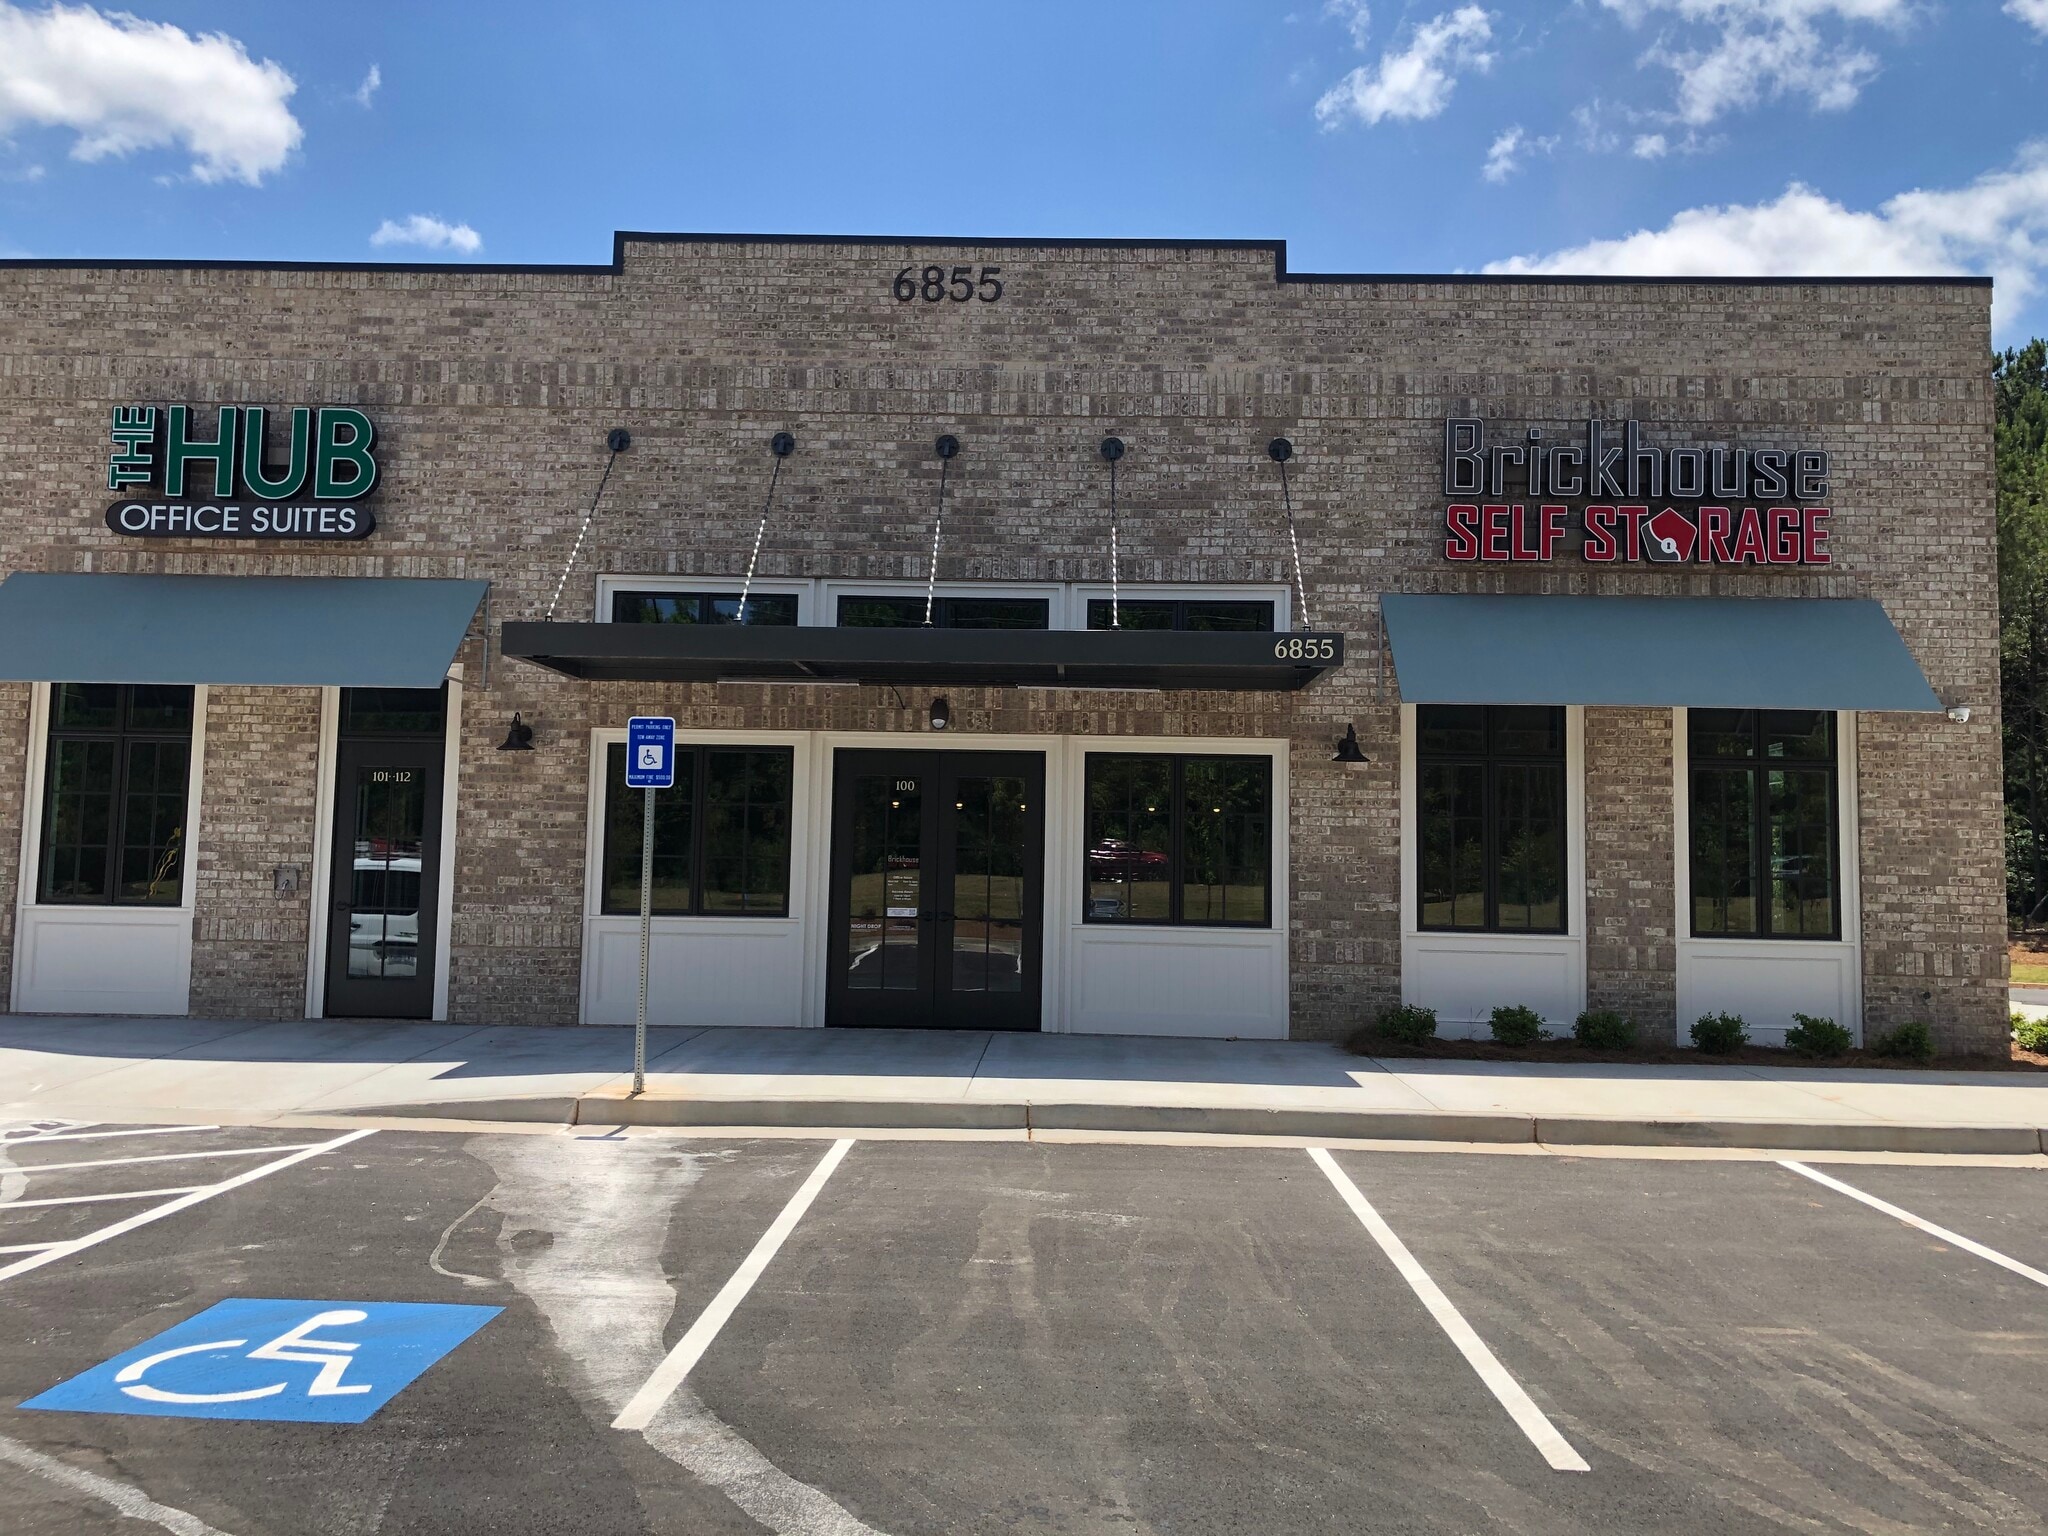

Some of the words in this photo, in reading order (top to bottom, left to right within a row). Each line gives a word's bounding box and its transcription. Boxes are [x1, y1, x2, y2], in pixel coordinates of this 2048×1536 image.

[893, 265, 1003, 303] 6855
[108, 405, 156, 490] THE
[165, 404, 377, 500] HUB
[1445, 417, 1831, 499] Brickhouse
[119, 504, 241, 532] OFFICE
[251, 506, 358, 534] SUITES
[1446, 504, 1569, 562] SELF
[1274, 638, 1335, 659] 6855
[895, 780, 915, 791] 100
[887, 855, 919, 863] Brickhouse
